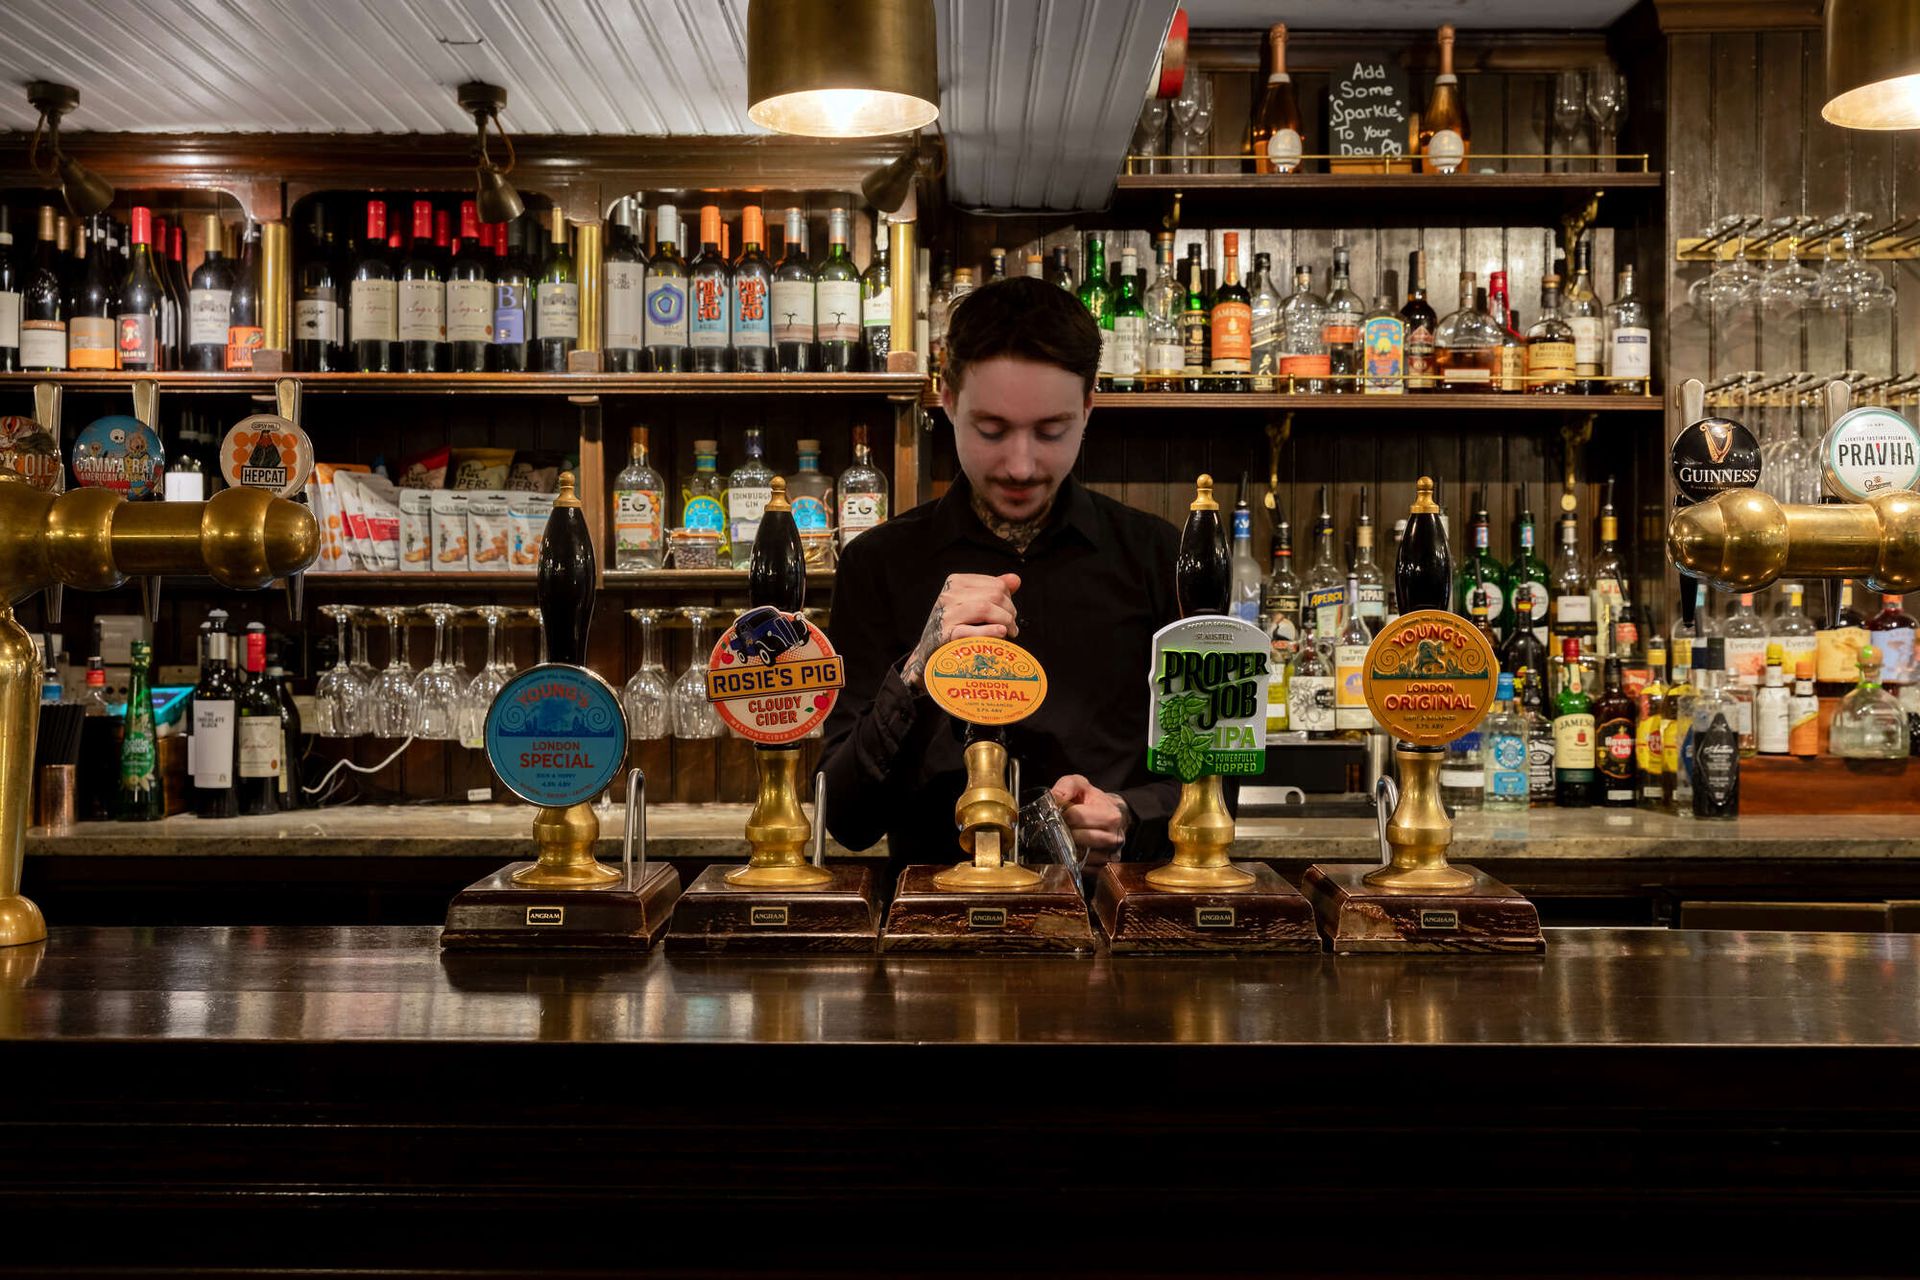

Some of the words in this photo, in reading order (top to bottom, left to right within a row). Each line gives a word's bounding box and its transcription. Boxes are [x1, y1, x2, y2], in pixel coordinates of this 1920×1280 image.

[1352, 62, 1385, 80] Add
[1340, 81, 1394, 98] Some
[1333, 99, 1399, 128] Sparkle
[1334, 125, 1354, 140] To
[1363, 125, 1392, 141] Your
[1340, 143, 1375, 157] Day
[1838, 442, 1915, 466] PRAVHA
[76, 457, 125, 473] GAMMA
[244, 469, 285, 483] HEPCAT
[1680, 467, 1759, 482] GUINNESS
[1311, 591, 1343, 605] APEROL
[1391, 623, 1468, 648] YOUNG'S
[950, 645, 1017, 662] YOUNG'S
[1156, 649, 1269, 696] PROPER
[966, 681, 1008, 689] LONDON
[1406, 682, 1454, 693] LONDON
[516, 682, 592, 709] YOUNG'S
[947, 688, 1030, 701] ORIGINAL
[1384, 694, 1476, 711] ORIGINAL
[748, 696, 802, 713] CLOUDY
[1197, 680, 1258, 730] JOB
[756, 710, 798, 726] CIDER
[1214, 725, 1257, 749] IPA
[532, 741, 580, 751] LONDON
[519, 753, 595, 769] SPECIAL
[1215, 753, 1257, 763] POWERFULLY
[1215, 763, 1257, 773] HOPPED
